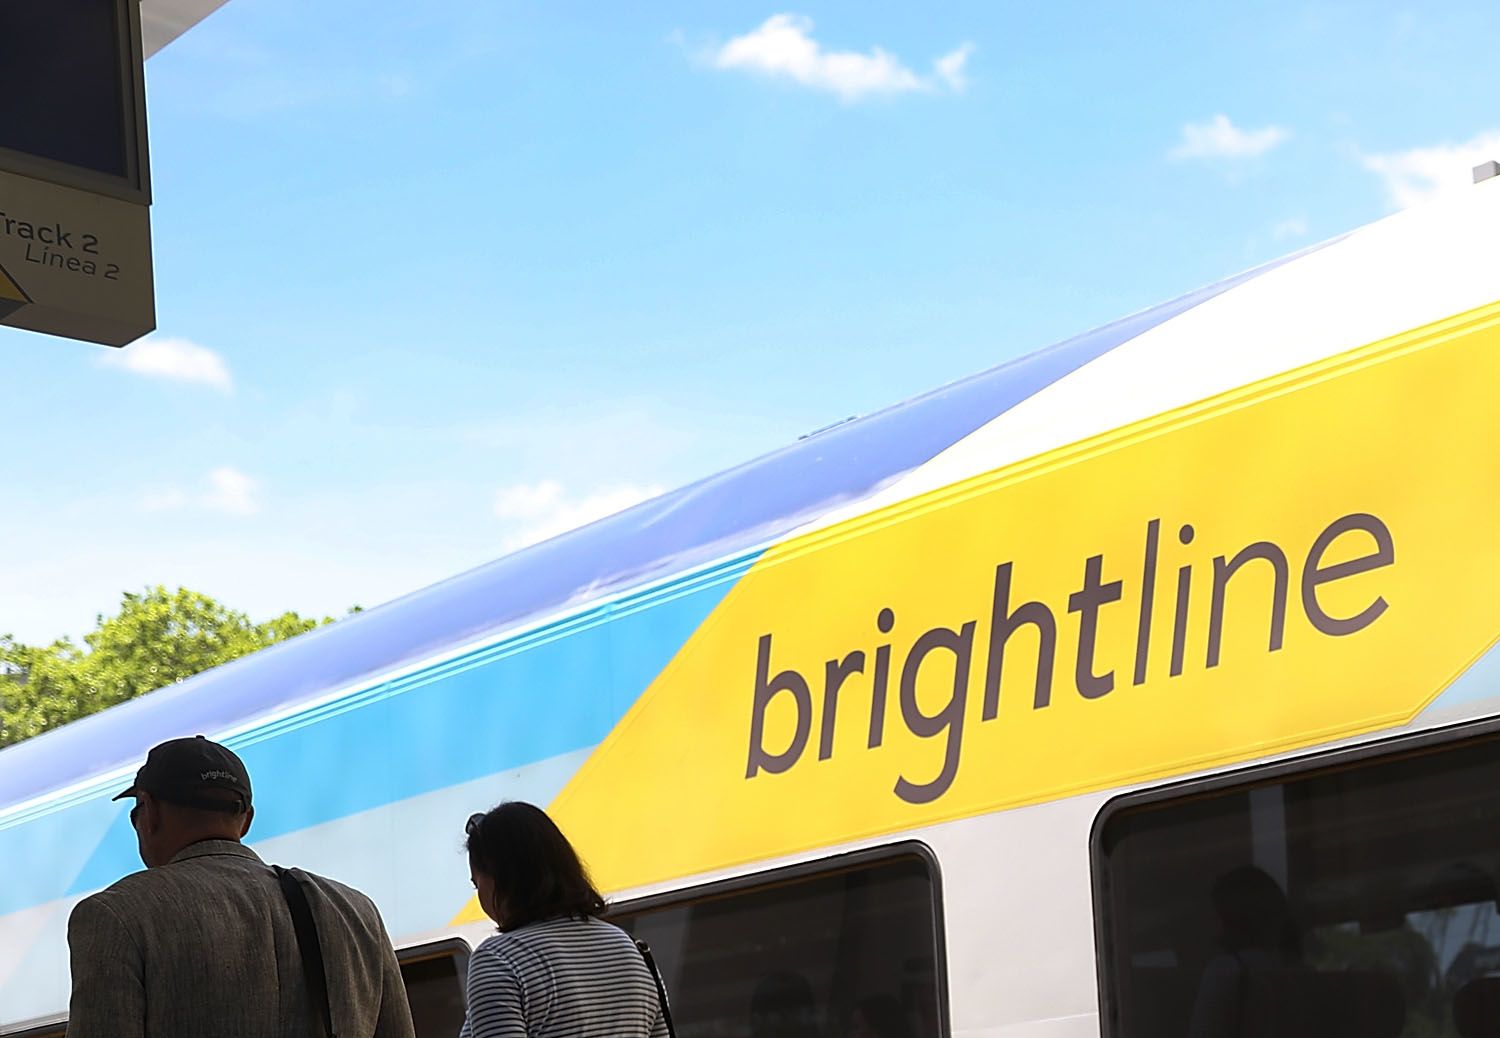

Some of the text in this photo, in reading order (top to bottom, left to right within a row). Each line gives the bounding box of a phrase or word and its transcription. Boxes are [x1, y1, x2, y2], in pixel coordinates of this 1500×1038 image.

[81, 234, 99, 255] 2
[103, 263, 120, 281] 2
[745, 512, 1396, 805] brightline
